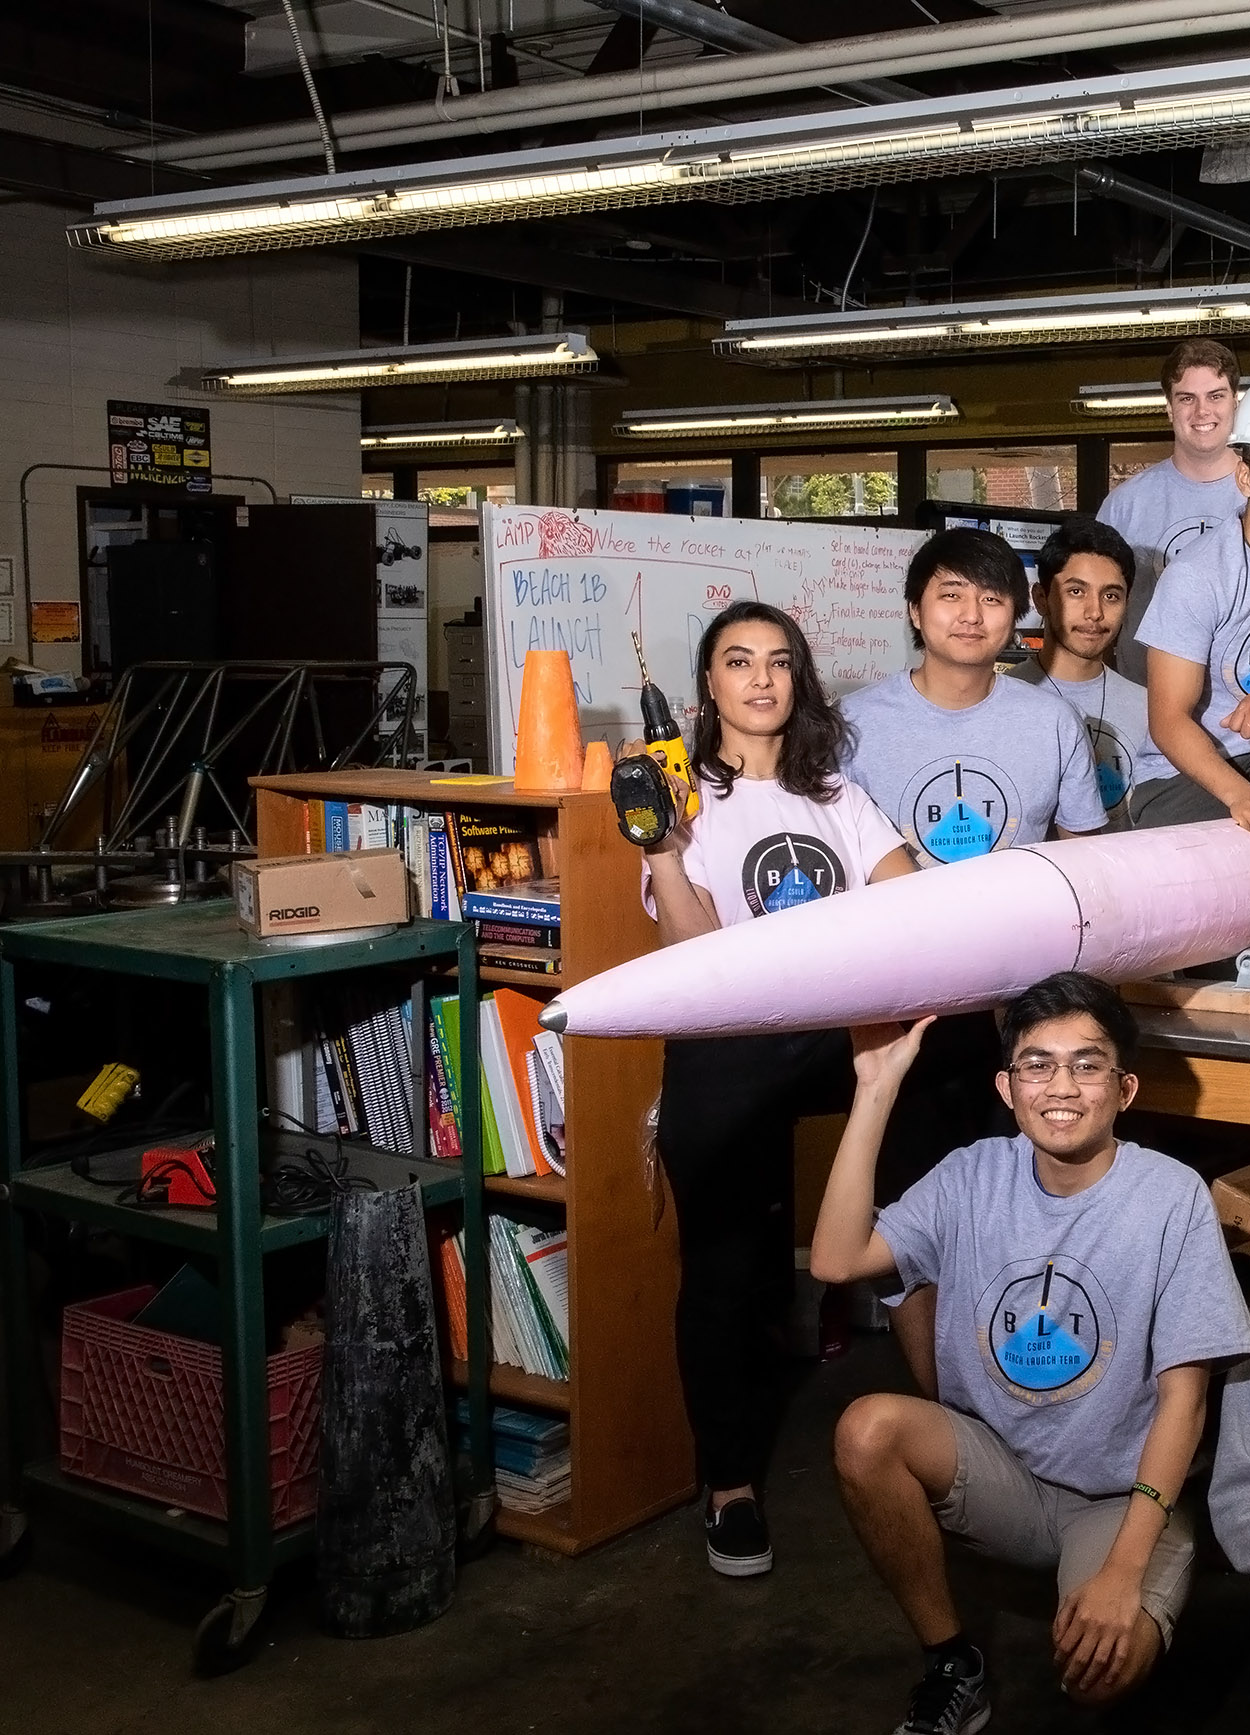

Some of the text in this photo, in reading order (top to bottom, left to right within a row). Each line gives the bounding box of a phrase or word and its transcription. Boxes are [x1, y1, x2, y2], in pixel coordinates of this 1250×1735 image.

[147, 416, 182, 433] SAE
[131, 454, 149, 463] EBC
[591, 522, 637, 553] Where
[647, 534, 672, 555] the
[680, 538, 727, 558] rocket
[512, 568, 571, 608] BEACH
[706, 584, 731, 599] DVD
[829, 576, 848, 591] Make
[849, 578, 870, 598] bigger
[831, 602, 904, 620] Finalize nosecone
[510, 613, 603, 669] LAUNCH
[830, 628, 867, 656] Integrate
[831, 660, 868, 680] Conduct
[461, 825, 498, 837] Software
[952, 824, 971, 833] CSULB
[931, 837, 950, 847] BEACH
[952, 836, 976, 846] LAUNCH
[430, 833, 439, 903] Administration
[438, 834, 448, 912] TCP/IP Network
[269, 906, 321, 921] RIDGID
[481, 931, 536, 944] AND THE COMPUTER
[482, 923, 542, 938] TELECOMMUNICATIONS
[495, 959, 507, 967] KEN
[429, 1037, 441, 1056] GRE
[433, 1054, 447, 1087] PREMIER
[1027, 1340, 1051, 1351] CSULB
[1004, 1352, 1081, 1366] BEACH LAUNCH TEAM
[163, 1468, 202, 1487] CREAMERY
